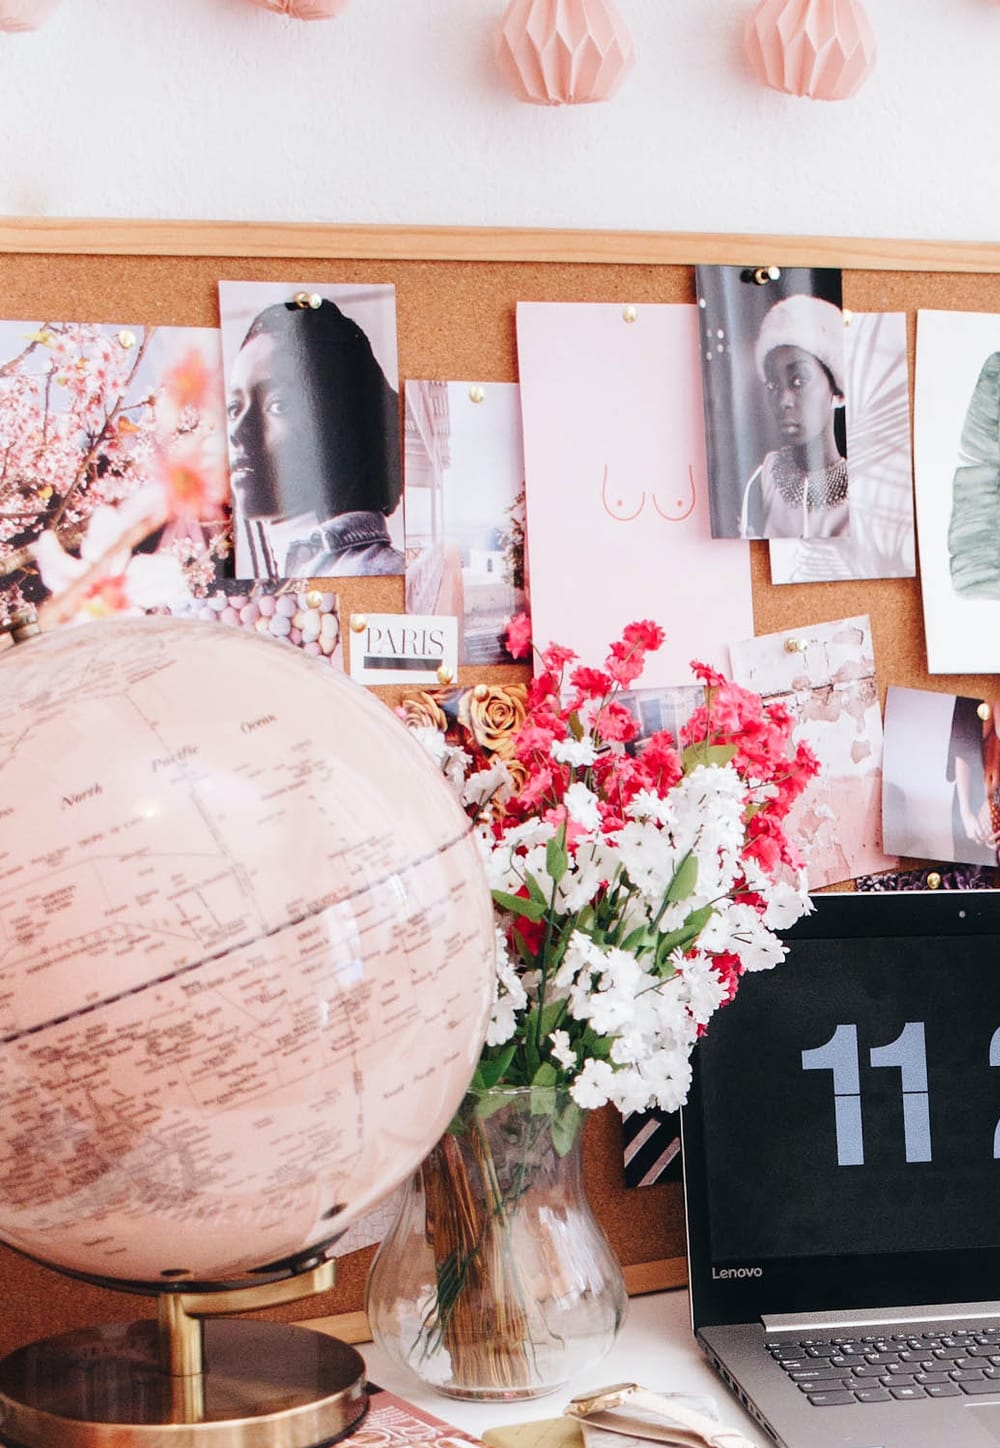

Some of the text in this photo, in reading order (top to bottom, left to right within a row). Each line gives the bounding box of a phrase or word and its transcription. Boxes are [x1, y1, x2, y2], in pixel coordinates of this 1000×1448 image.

[367, 627, 444, 655] PARIS
[61, 714, 278, 809] North Pacific Ocean
[802, 1022, 932, 1166] 11
[712, 1267, 763, 1279] Lenovo
